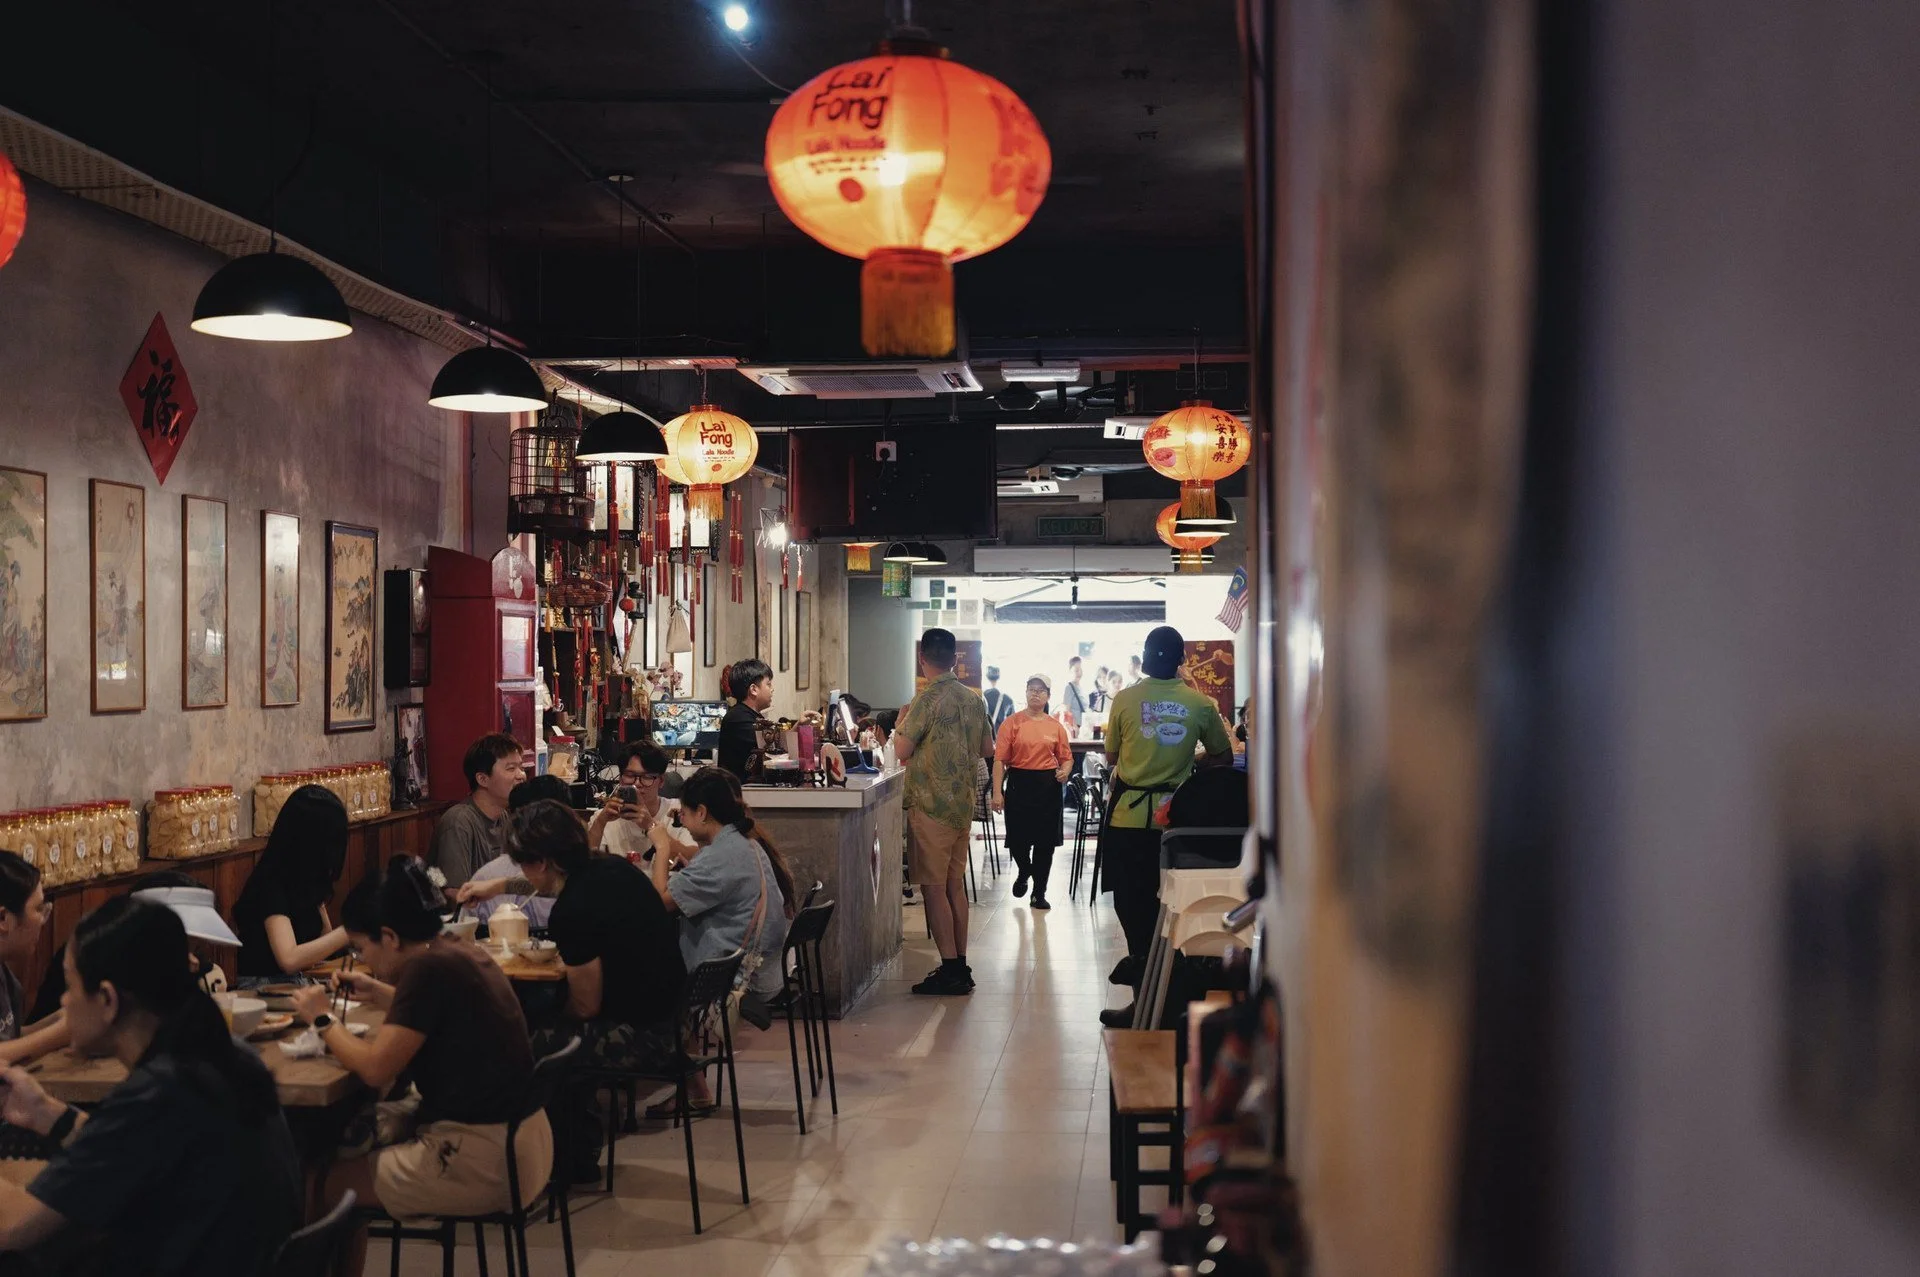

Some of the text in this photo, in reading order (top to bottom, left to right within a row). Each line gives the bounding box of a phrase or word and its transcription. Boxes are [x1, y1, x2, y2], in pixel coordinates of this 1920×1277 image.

[826, 66, 894, 91] Lai
[808, 92, 889, 129] Fong
[137, 350, 180, 445] 福
[701, 421, 727, 432] Lai
[700, 432, 733, 447] Fong
